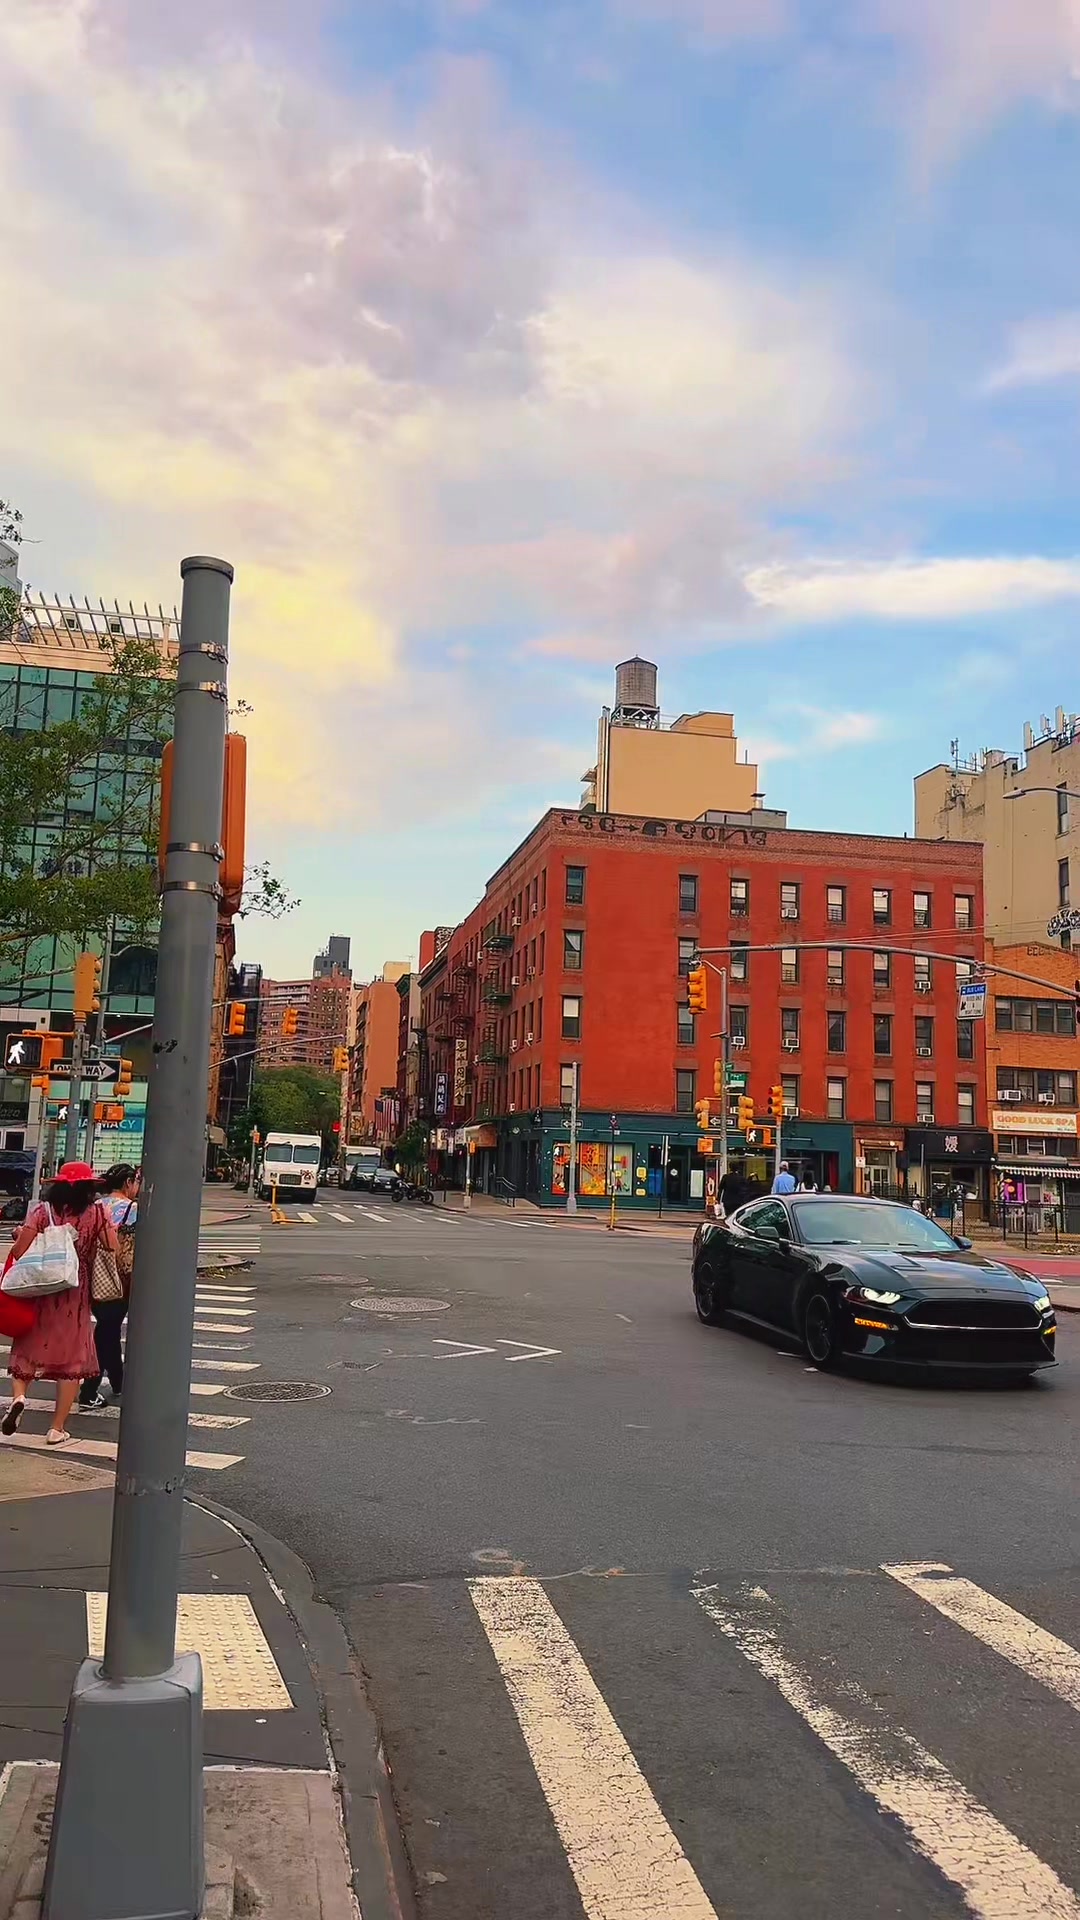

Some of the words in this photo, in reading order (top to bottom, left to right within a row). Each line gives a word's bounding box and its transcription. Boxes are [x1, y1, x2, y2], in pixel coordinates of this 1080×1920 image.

[85, 1066, 107, 1076] WAY
[997, 1115, 1027, 1124] GOOD
[1028, 1116, 1055, 1126] LUCK
[1056, 1117, 1076, 1127] SPA
